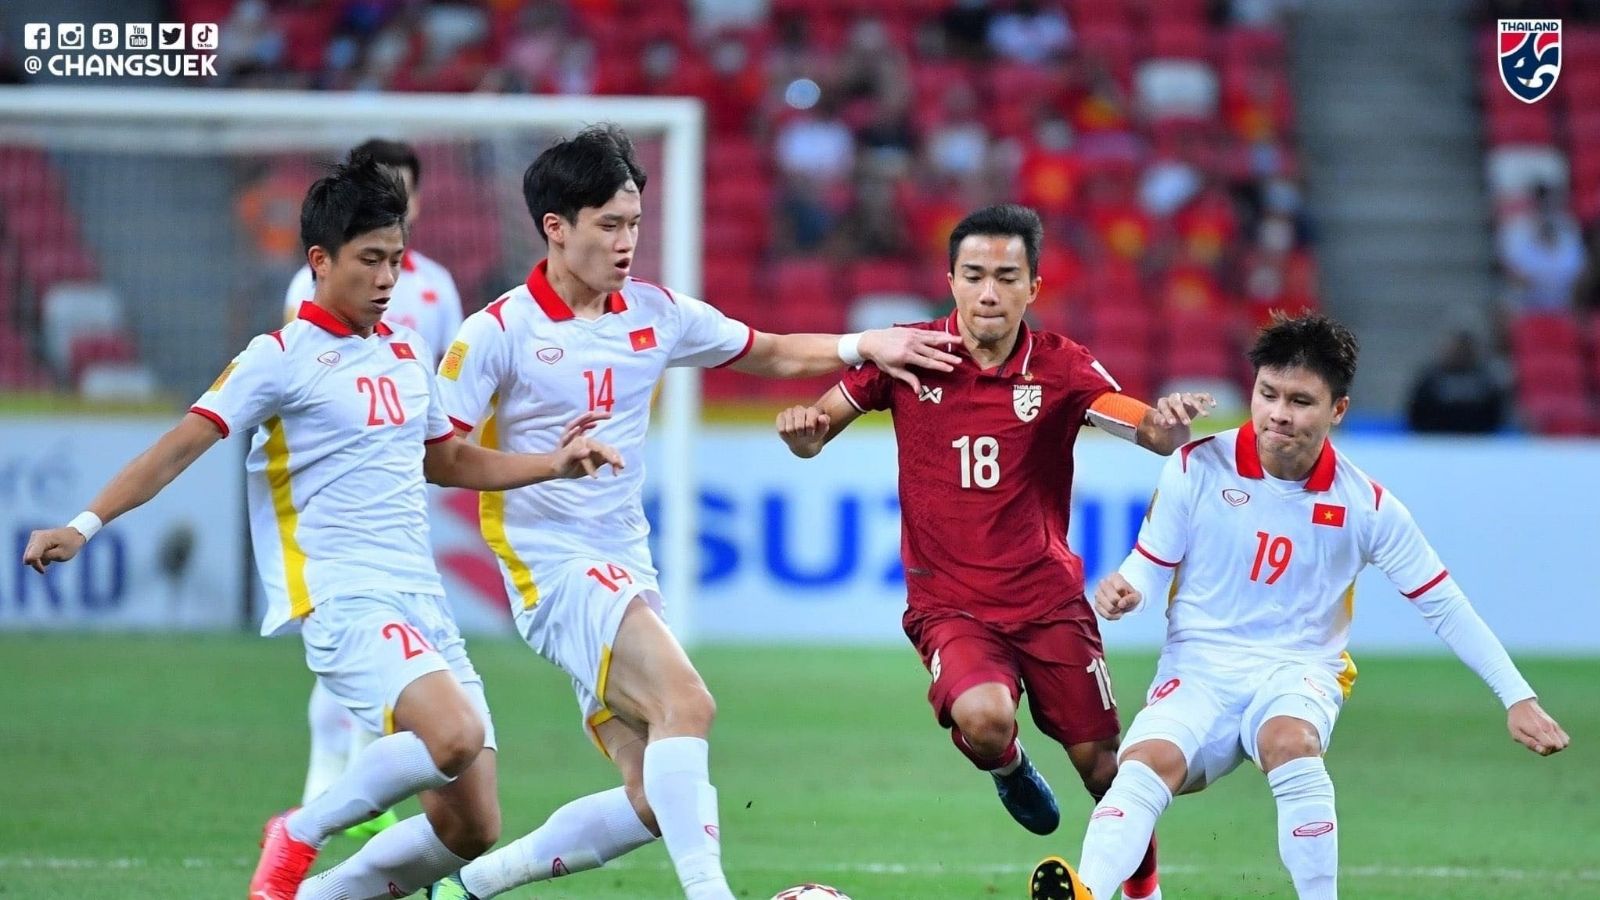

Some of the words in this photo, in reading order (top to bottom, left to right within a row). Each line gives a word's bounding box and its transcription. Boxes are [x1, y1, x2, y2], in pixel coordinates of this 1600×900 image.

[356, 376, 405, 426] 20
[583, 367, 615, 412] 14
[952, 435, 1000, 488] 18
[1250, 530, 1293, 585] 19
